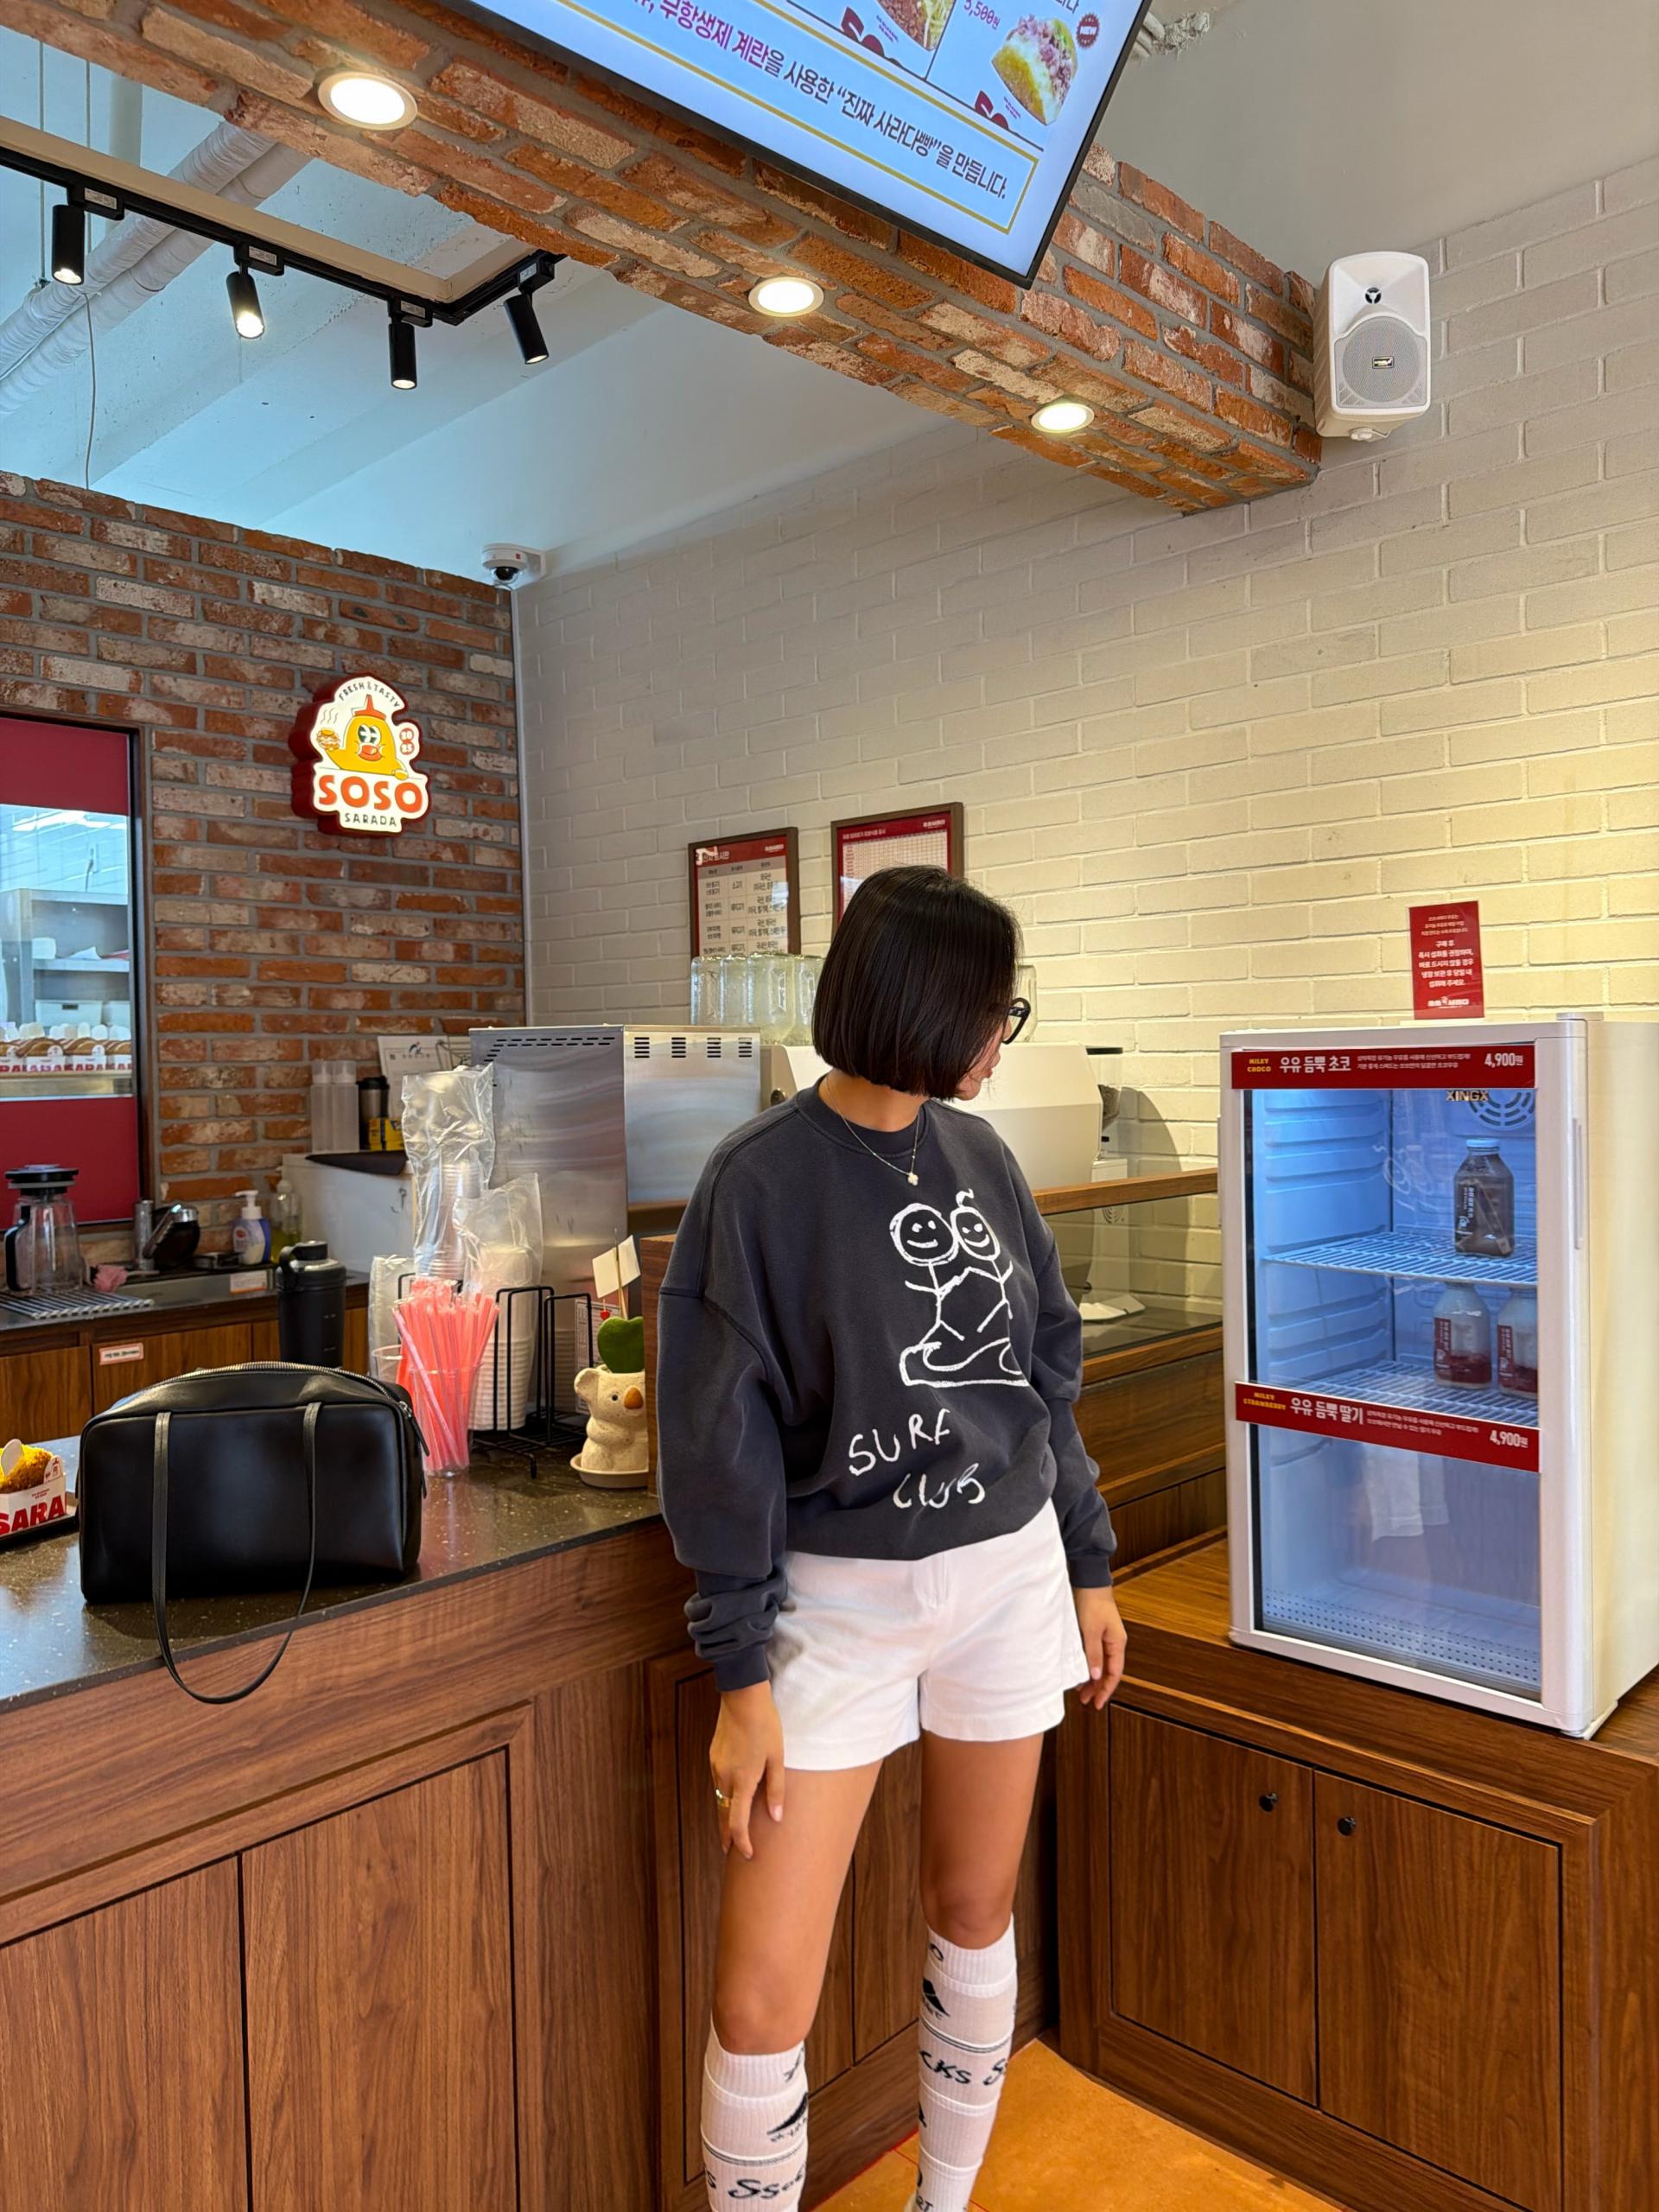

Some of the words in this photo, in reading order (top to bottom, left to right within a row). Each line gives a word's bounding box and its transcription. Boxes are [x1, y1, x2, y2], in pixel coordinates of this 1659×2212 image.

[1080, 26, 1097, 35] NEW
[732, 30, 785, 78] 계란을
[784, 60, 835, 104] 사용한
[952, 152, 1008, 200] 만듭니다.
[318, 774, 423, 814] SOSO
[345, 812, 397, 827] SARADA
[1279, 1056, 1301, 1073] 우유
[1303, 1055, 1326, 1073] 듬뿍
[1328, 1055, 1351, 1071] 초코
[1484, 1052, 1524, 1068] 4,900원
[1446, 1090, 1489, 1102] XINGX
[1289, 1397, 1313, 1416] 우유
[1314, 1401, 1338, 1421] 듬뿍
[1339, 1404, 1364, 1425] 딸기
[1489, 1430, 1529, 1448] 4,900원
